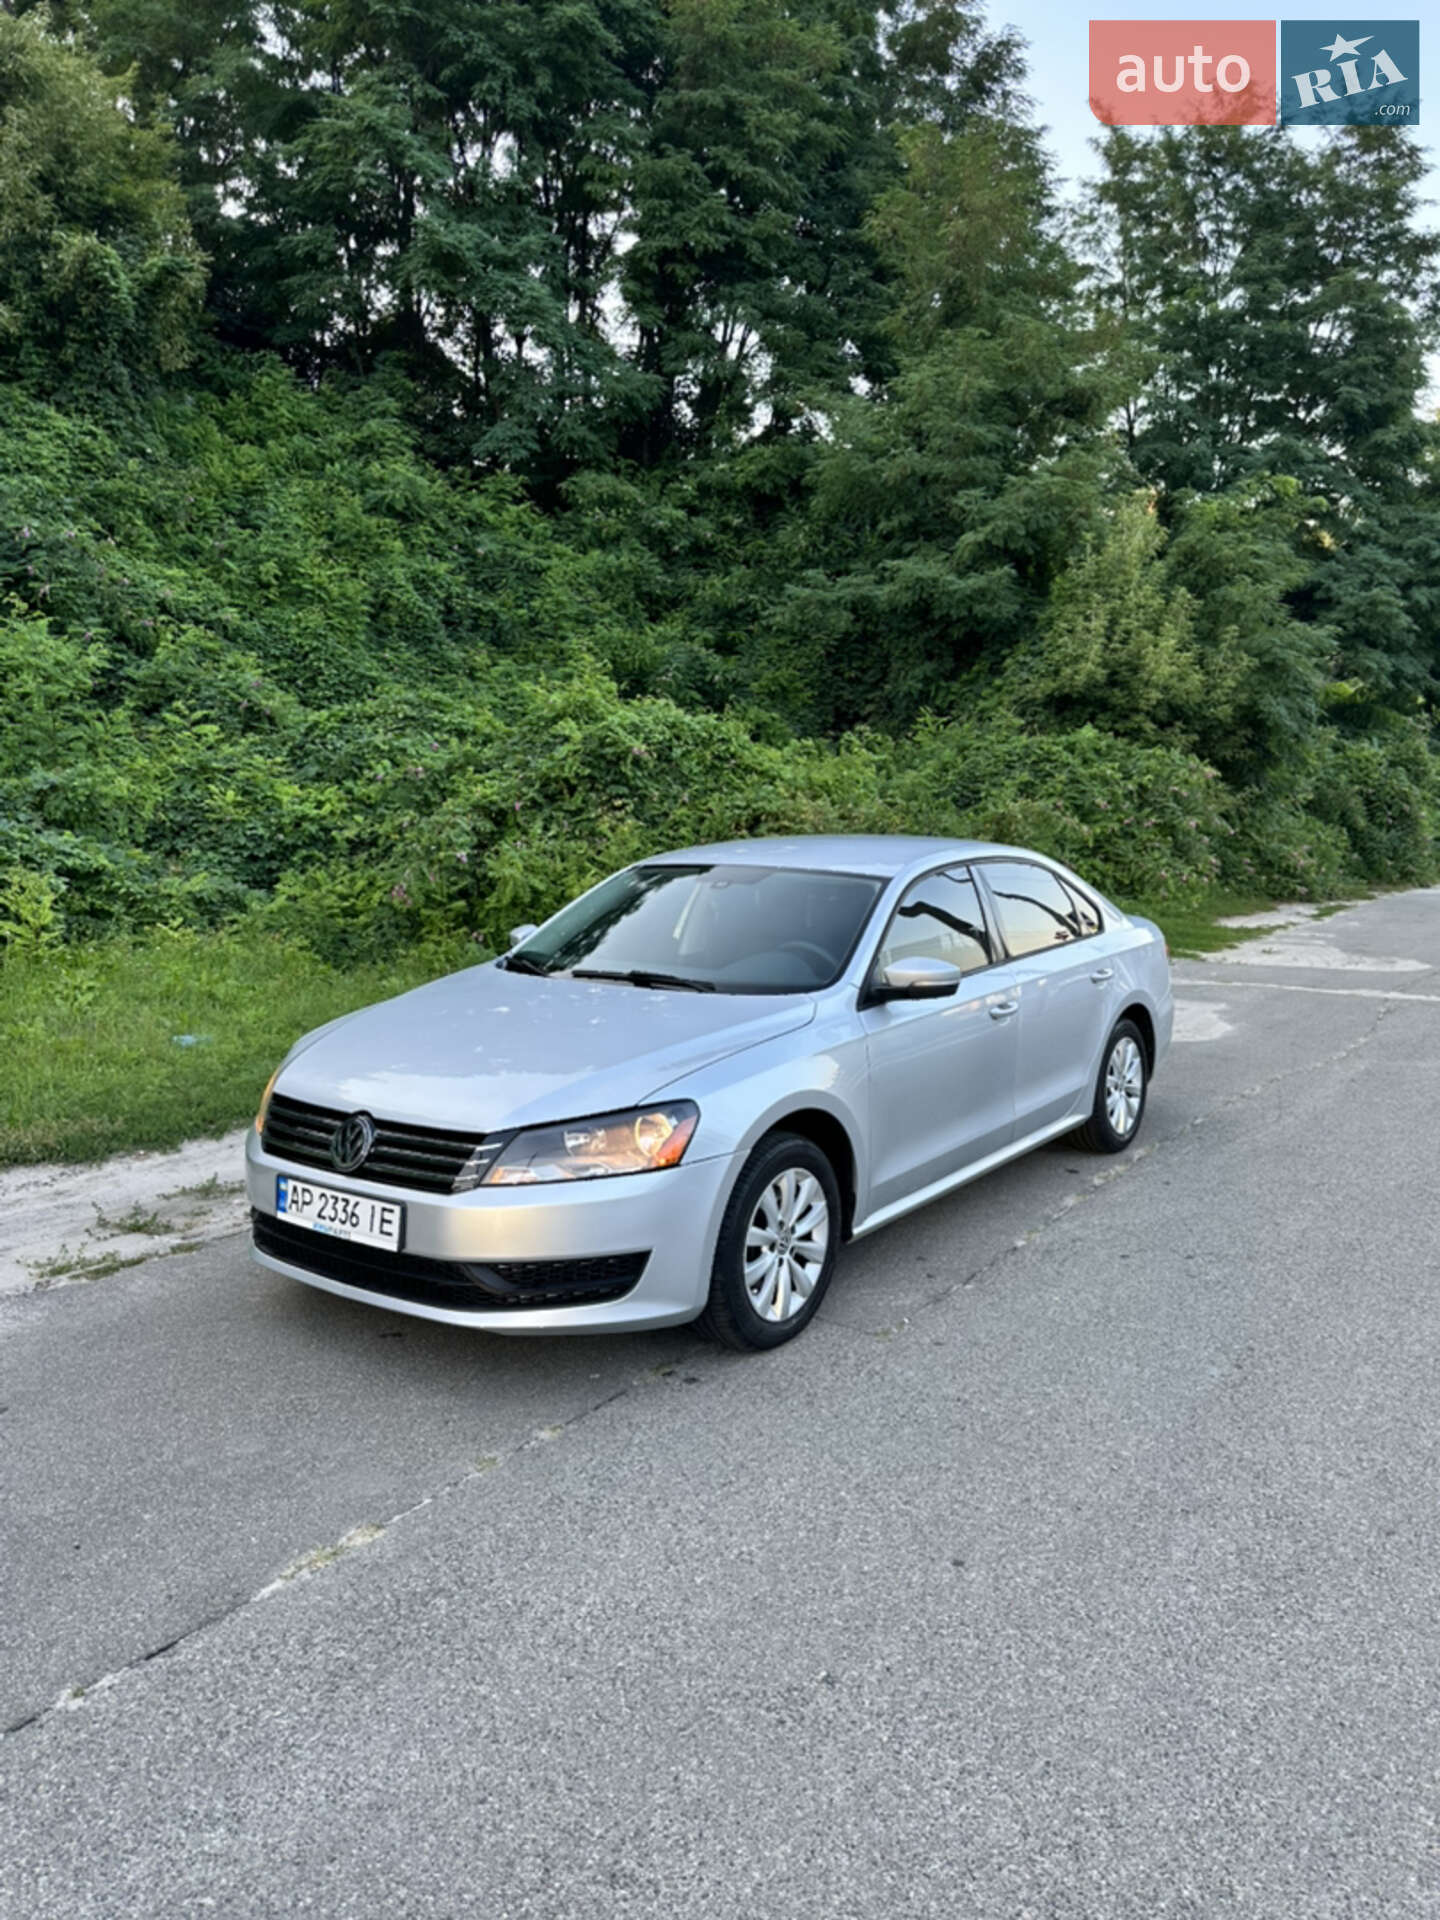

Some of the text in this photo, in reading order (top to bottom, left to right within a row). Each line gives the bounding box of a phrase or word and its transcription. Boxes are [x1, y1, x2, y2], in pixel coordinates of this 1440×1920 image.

[289, 1185, 313, 1212] AP
[317, 1193, 360, 1228] 2336
[369, 1205, 394, 1237] IE
